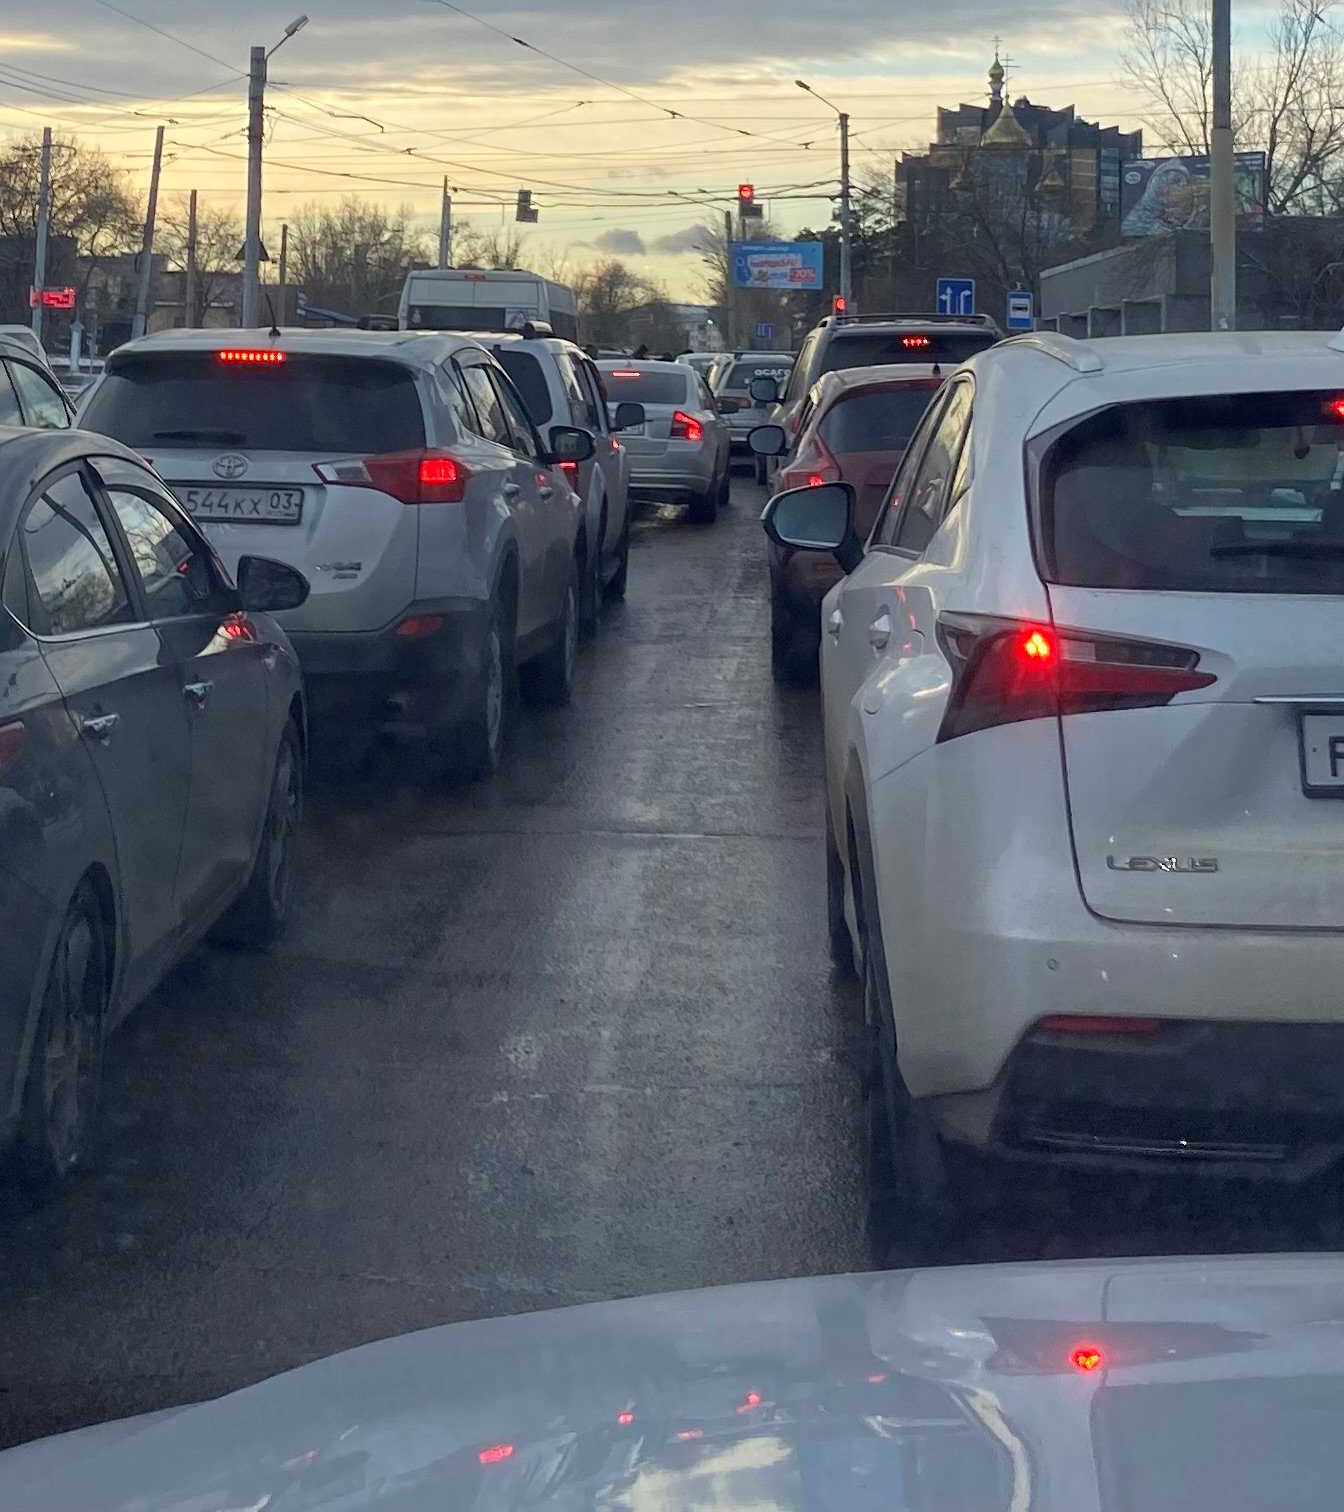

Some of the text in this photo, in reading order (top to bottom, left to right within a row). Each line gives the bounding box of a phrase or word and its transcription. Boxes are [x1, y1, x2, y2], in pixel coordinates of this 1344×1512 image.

[185, 491, 294, 515] 544КХ 03
[1106, 855, 1218, 873] LEXUS
